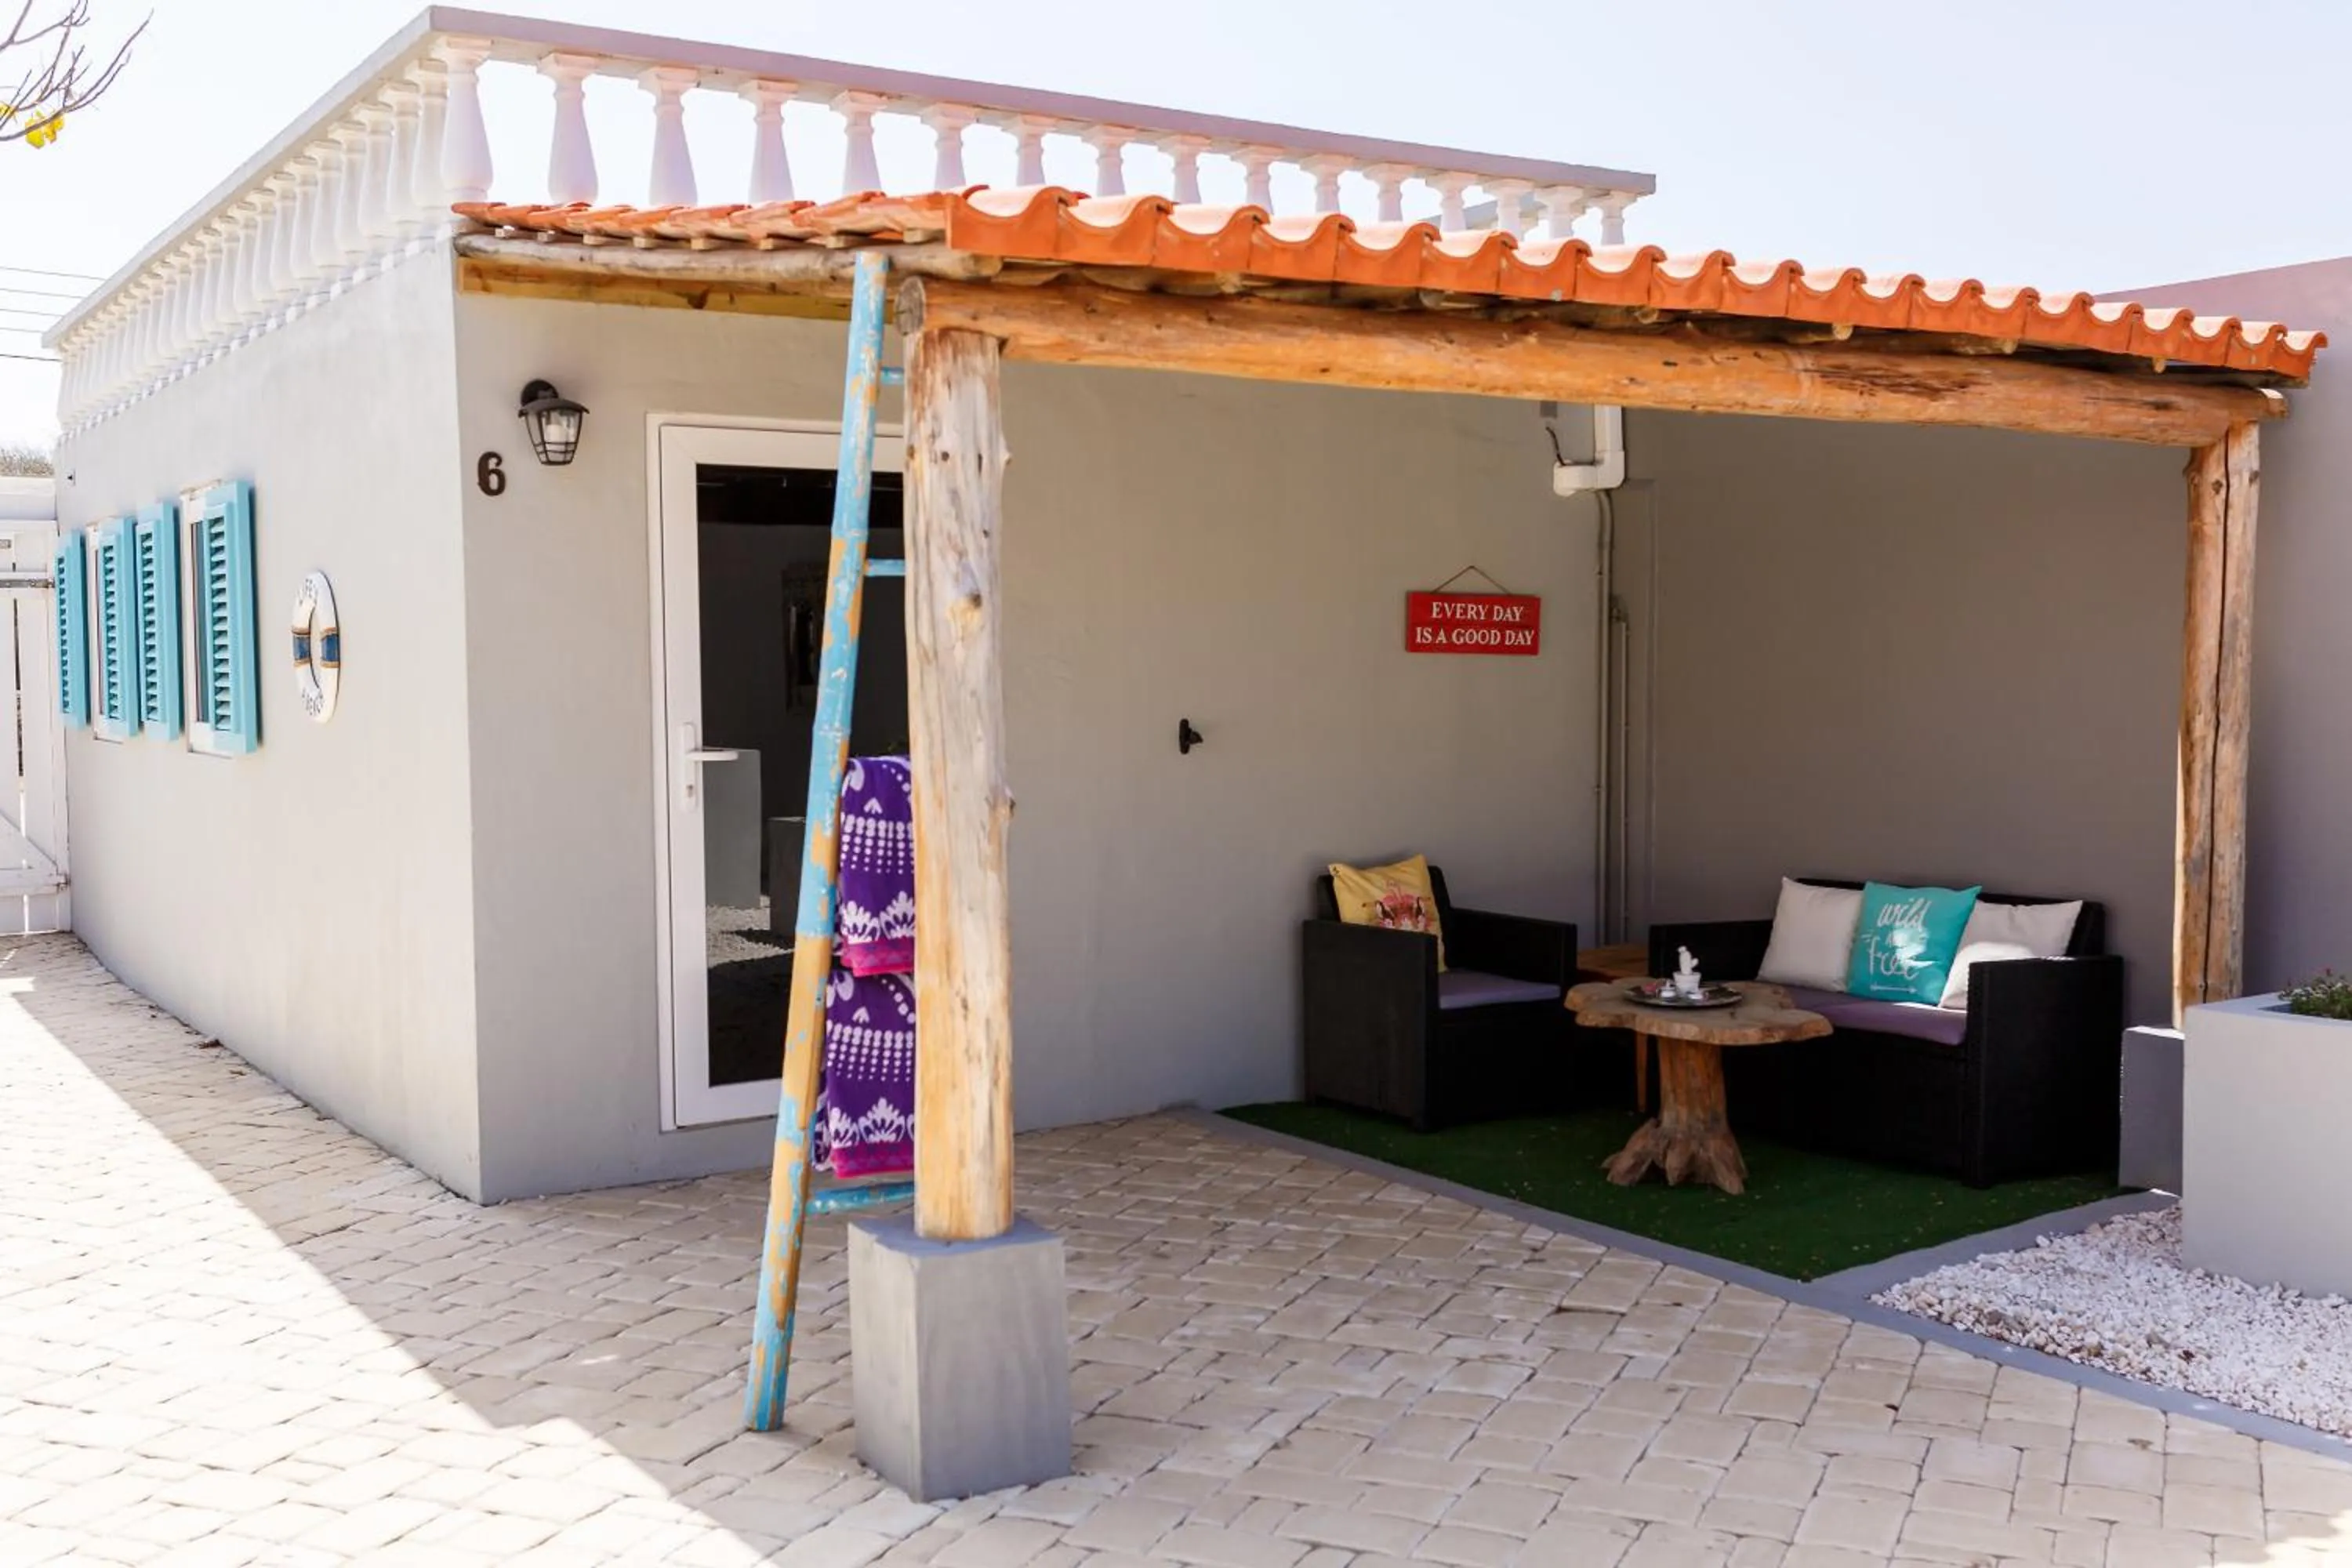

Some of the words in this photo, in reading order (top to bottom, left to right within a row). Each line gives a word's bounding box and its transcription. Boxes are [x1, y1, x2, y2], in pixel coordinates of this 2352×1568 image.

[477, 451, 506, 496] 6
[1430, 601, 1490, 620] EVERY
[1493, 605, 1524, 622] DAY
[1415, 626, 1432, 644] IS
[1436, 627, 1448, 644] A
[1451, 628, 1501, 645] GOOD
[1504, 630, 1534, 646] DAY
[1876, 898, 1933, 932] wild
